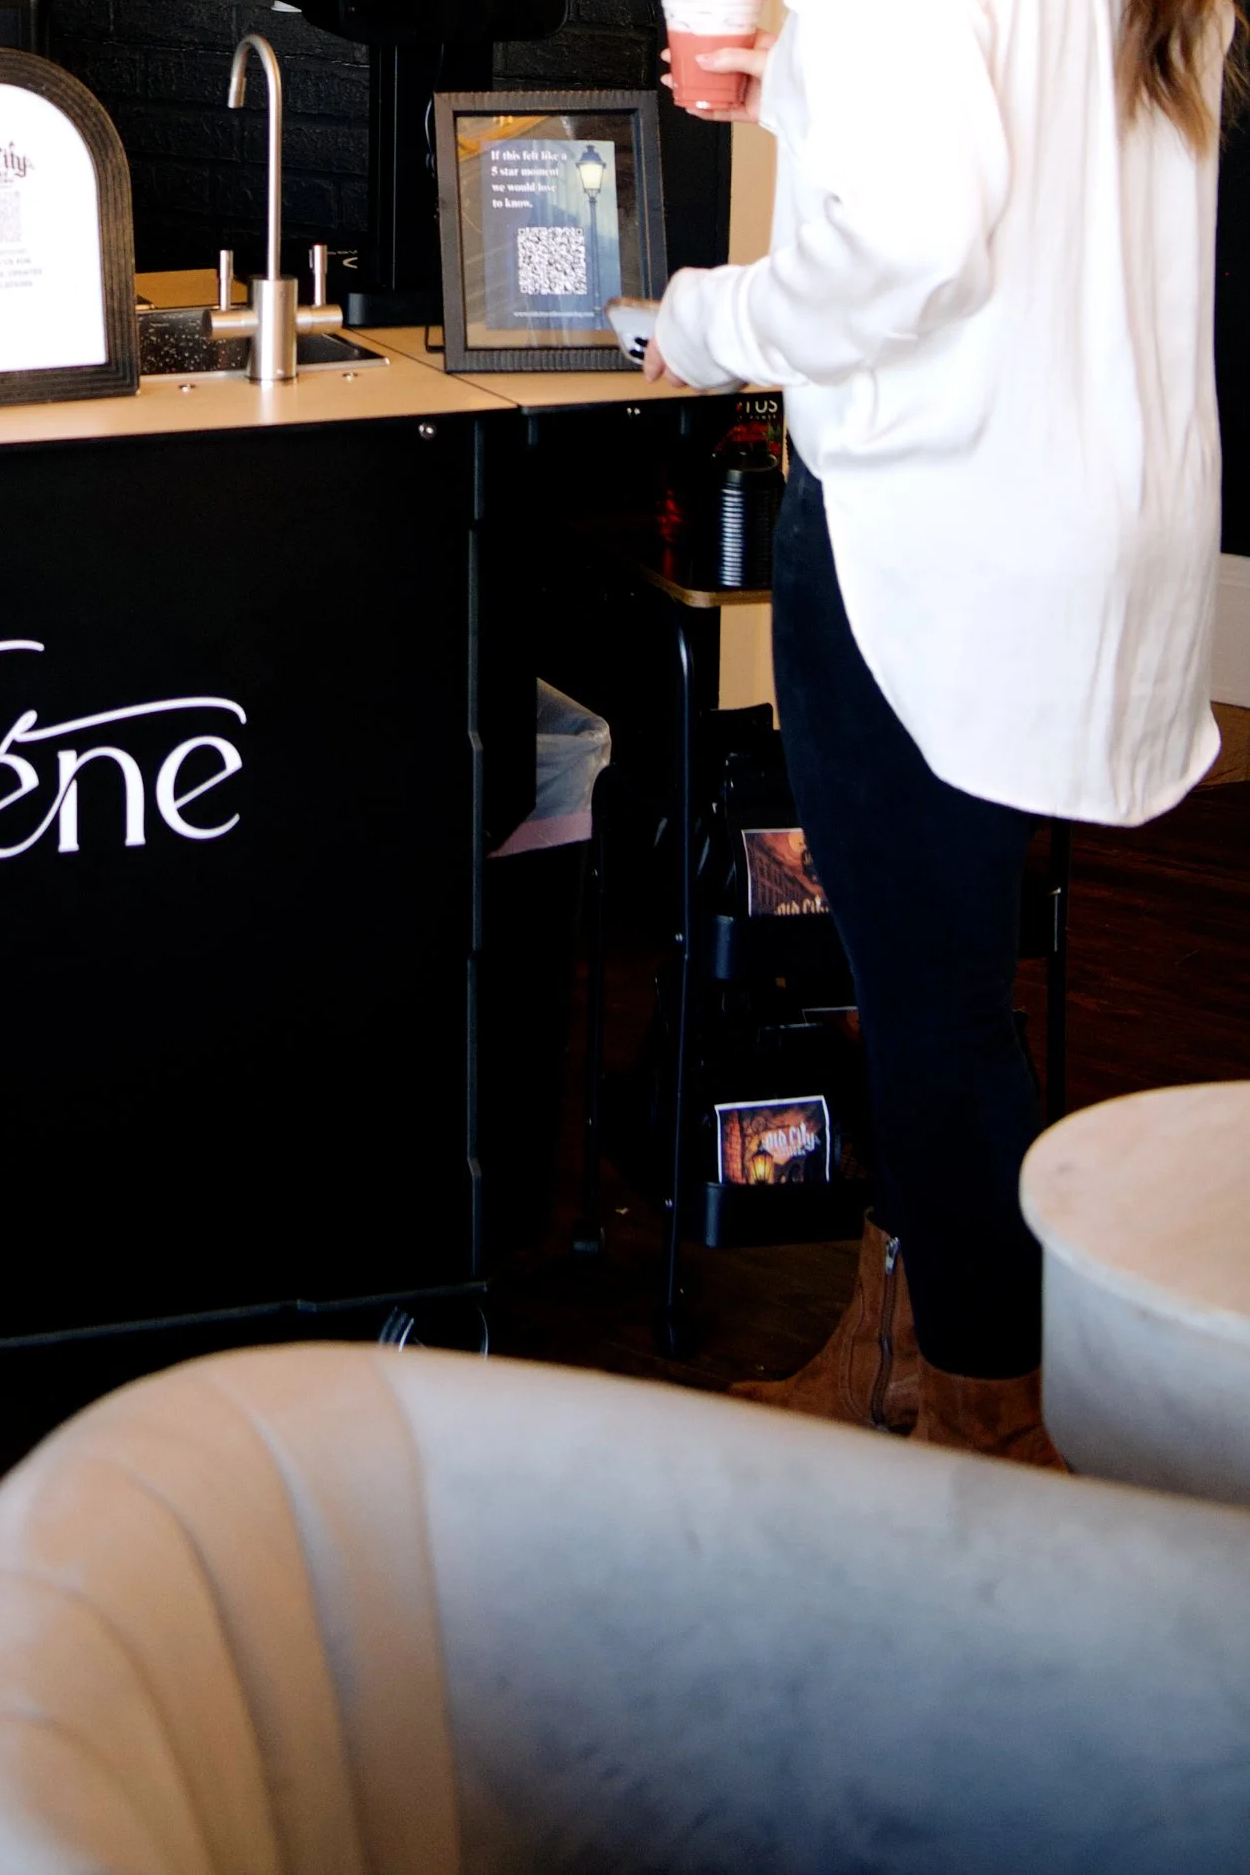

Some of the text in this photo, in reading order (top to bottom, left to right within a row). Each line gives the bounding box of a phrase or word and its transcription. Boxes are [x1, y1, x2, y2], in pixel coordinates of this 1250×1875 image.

[491, 149, 568, 161] If this felt like a
[491, 166, 559, 177] 5 star moment
[491, 181, 557, 192] we would love
[492, 197, 534, 209] to know.
[788, 1121, 815, 1152] City
